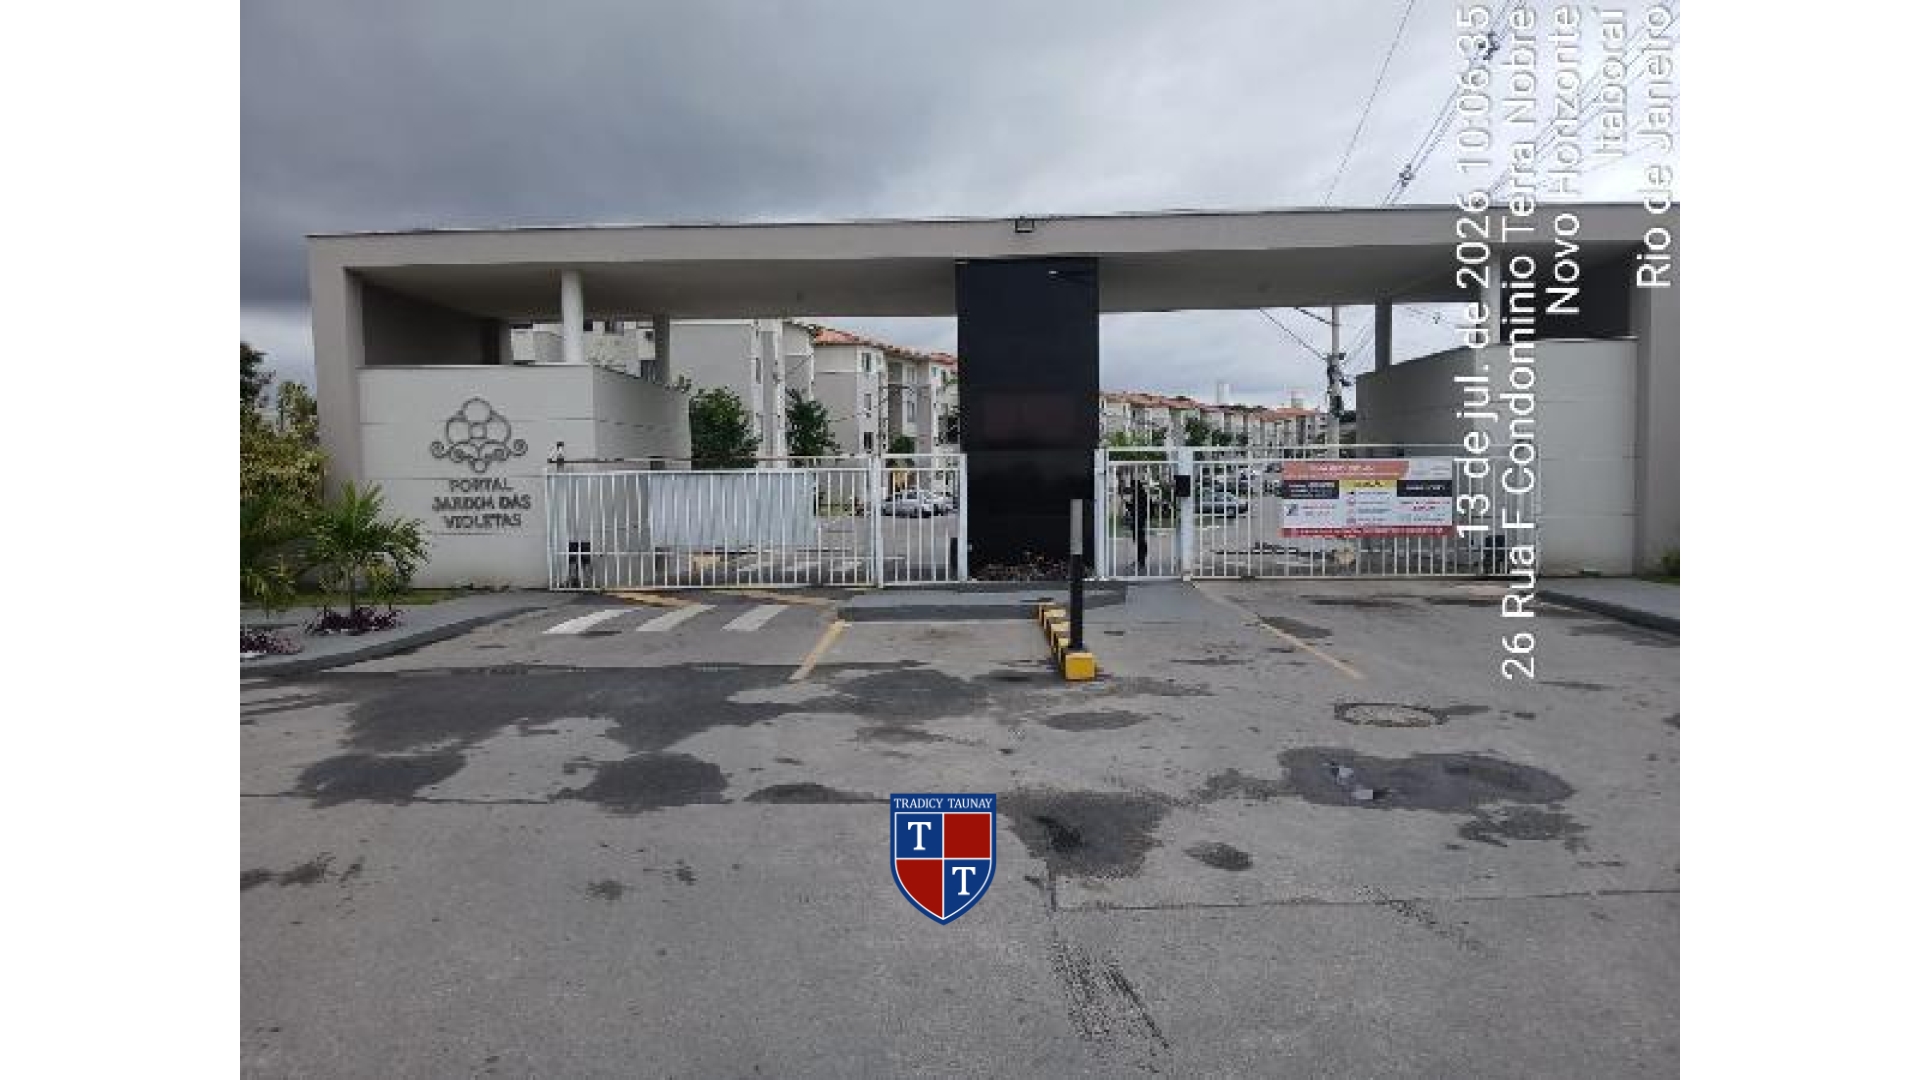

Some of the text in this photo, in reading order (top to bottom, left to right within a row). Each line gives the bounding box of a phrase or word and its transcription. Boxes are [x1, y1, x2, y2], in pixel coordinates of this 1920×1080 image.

[449, 477, 514, 493] PORTAL
[499, 494, 531, 510] DAS
[444, 514, 521, 529] VIOLETAS
